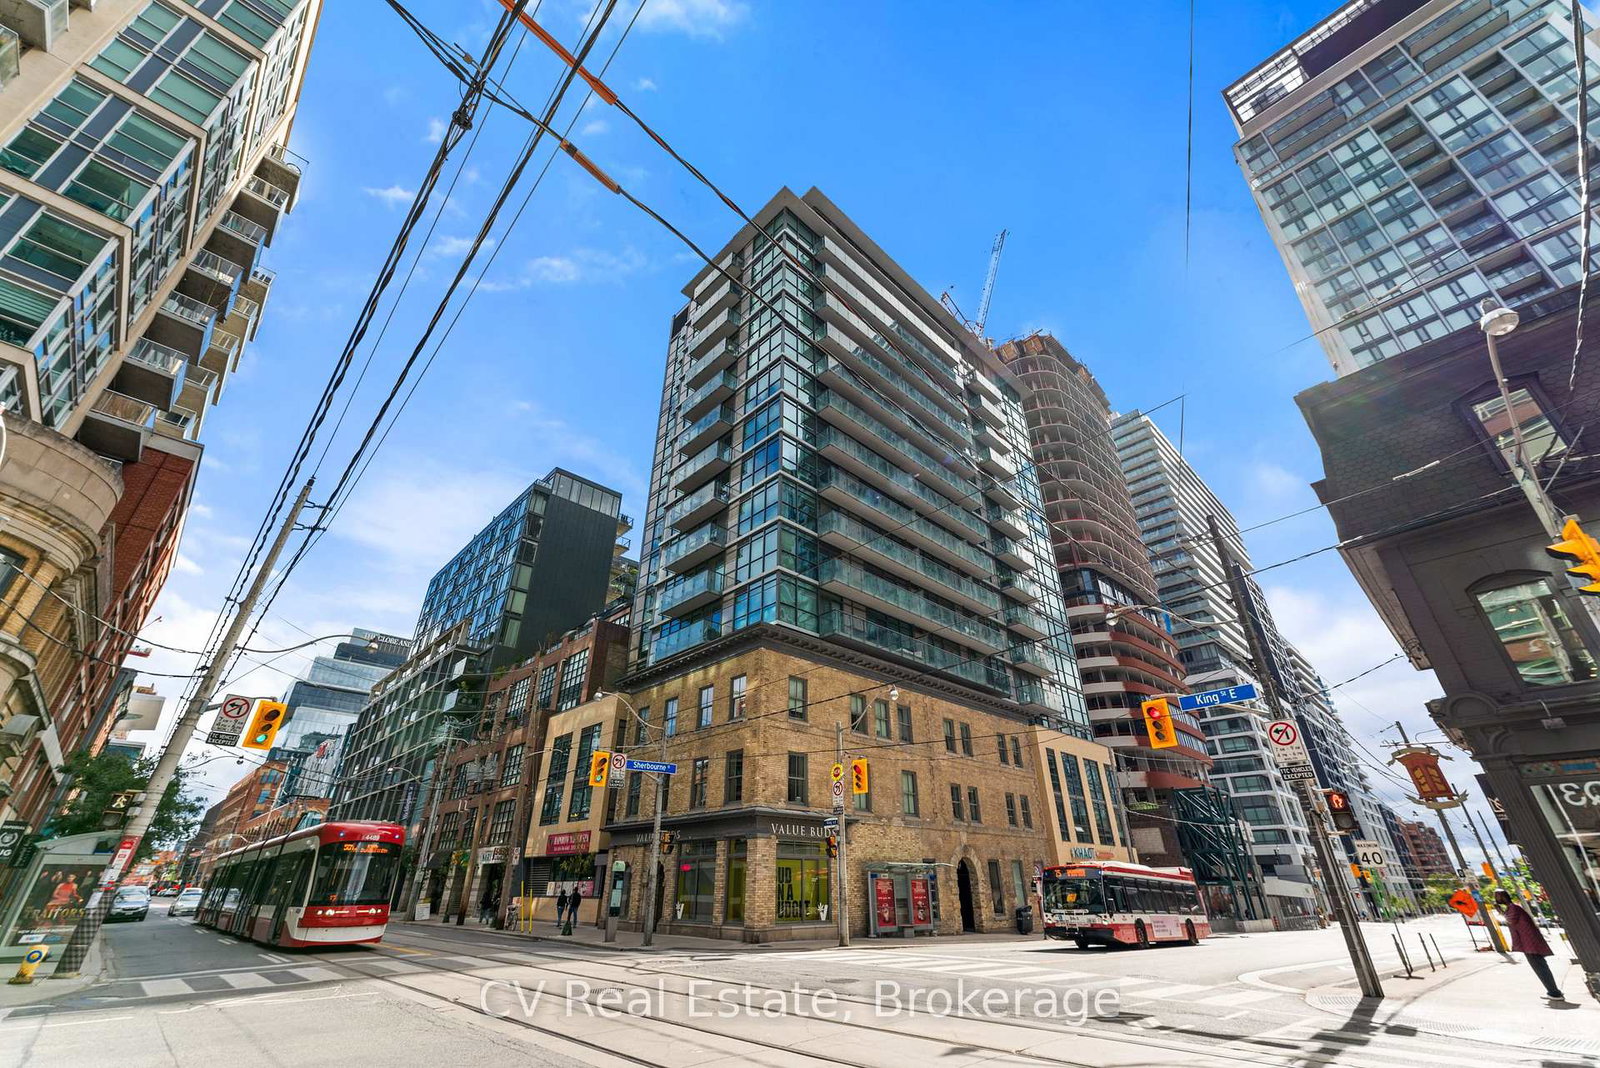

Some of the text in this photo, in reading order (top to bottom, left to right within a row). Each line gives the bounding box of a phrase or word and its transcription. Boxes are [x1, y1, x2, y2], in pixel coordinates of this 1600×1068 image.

[1195, 693, 1220, 705] King
[1229, 688, 1238, 699] E
[633, 761, 667, 771] Sherbourne
[1283, 772, 1313, 780] EXCEPTED
[771, 822, 806, 836] VALUE
[1361, 851, 1383, 865] 40
[787, 883, 793, 901] A
